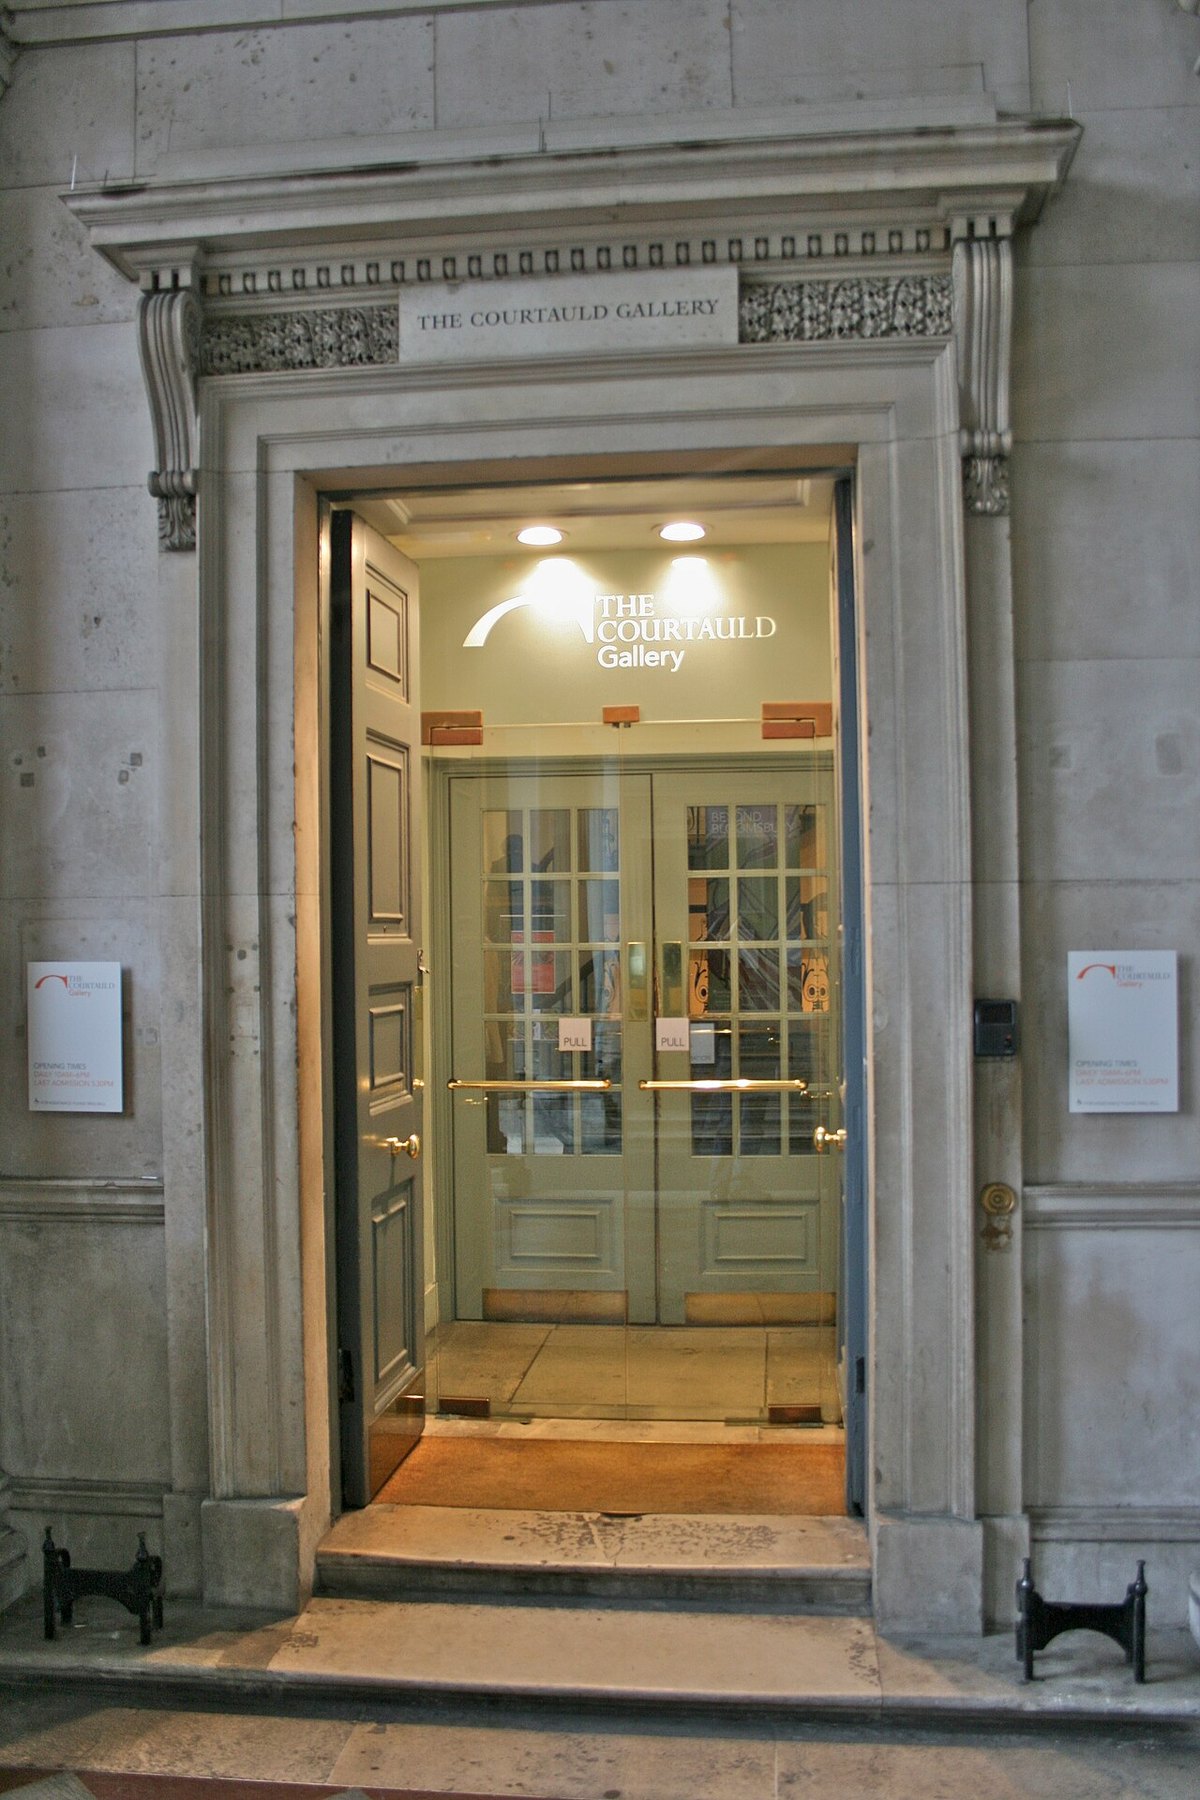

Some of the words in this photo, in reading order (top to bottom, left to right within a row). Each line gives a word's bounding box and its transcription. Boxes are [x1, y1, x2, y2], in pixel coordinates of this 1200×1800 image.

[416, 313, 463, 331] THE
[470, 304, 609, 327] COURTAULD
[616, 299, 720, 319] GALLERY
[595, 594, 655, 618] THE
[597, 616, 777, 643] COURTAULD
[597, 644, 685, 673] Gallery
[711, 811, 762, 823] BEOND
[563, 1037, 587, 1047] PULL
[660, 1037, 685, 1047] PULL
